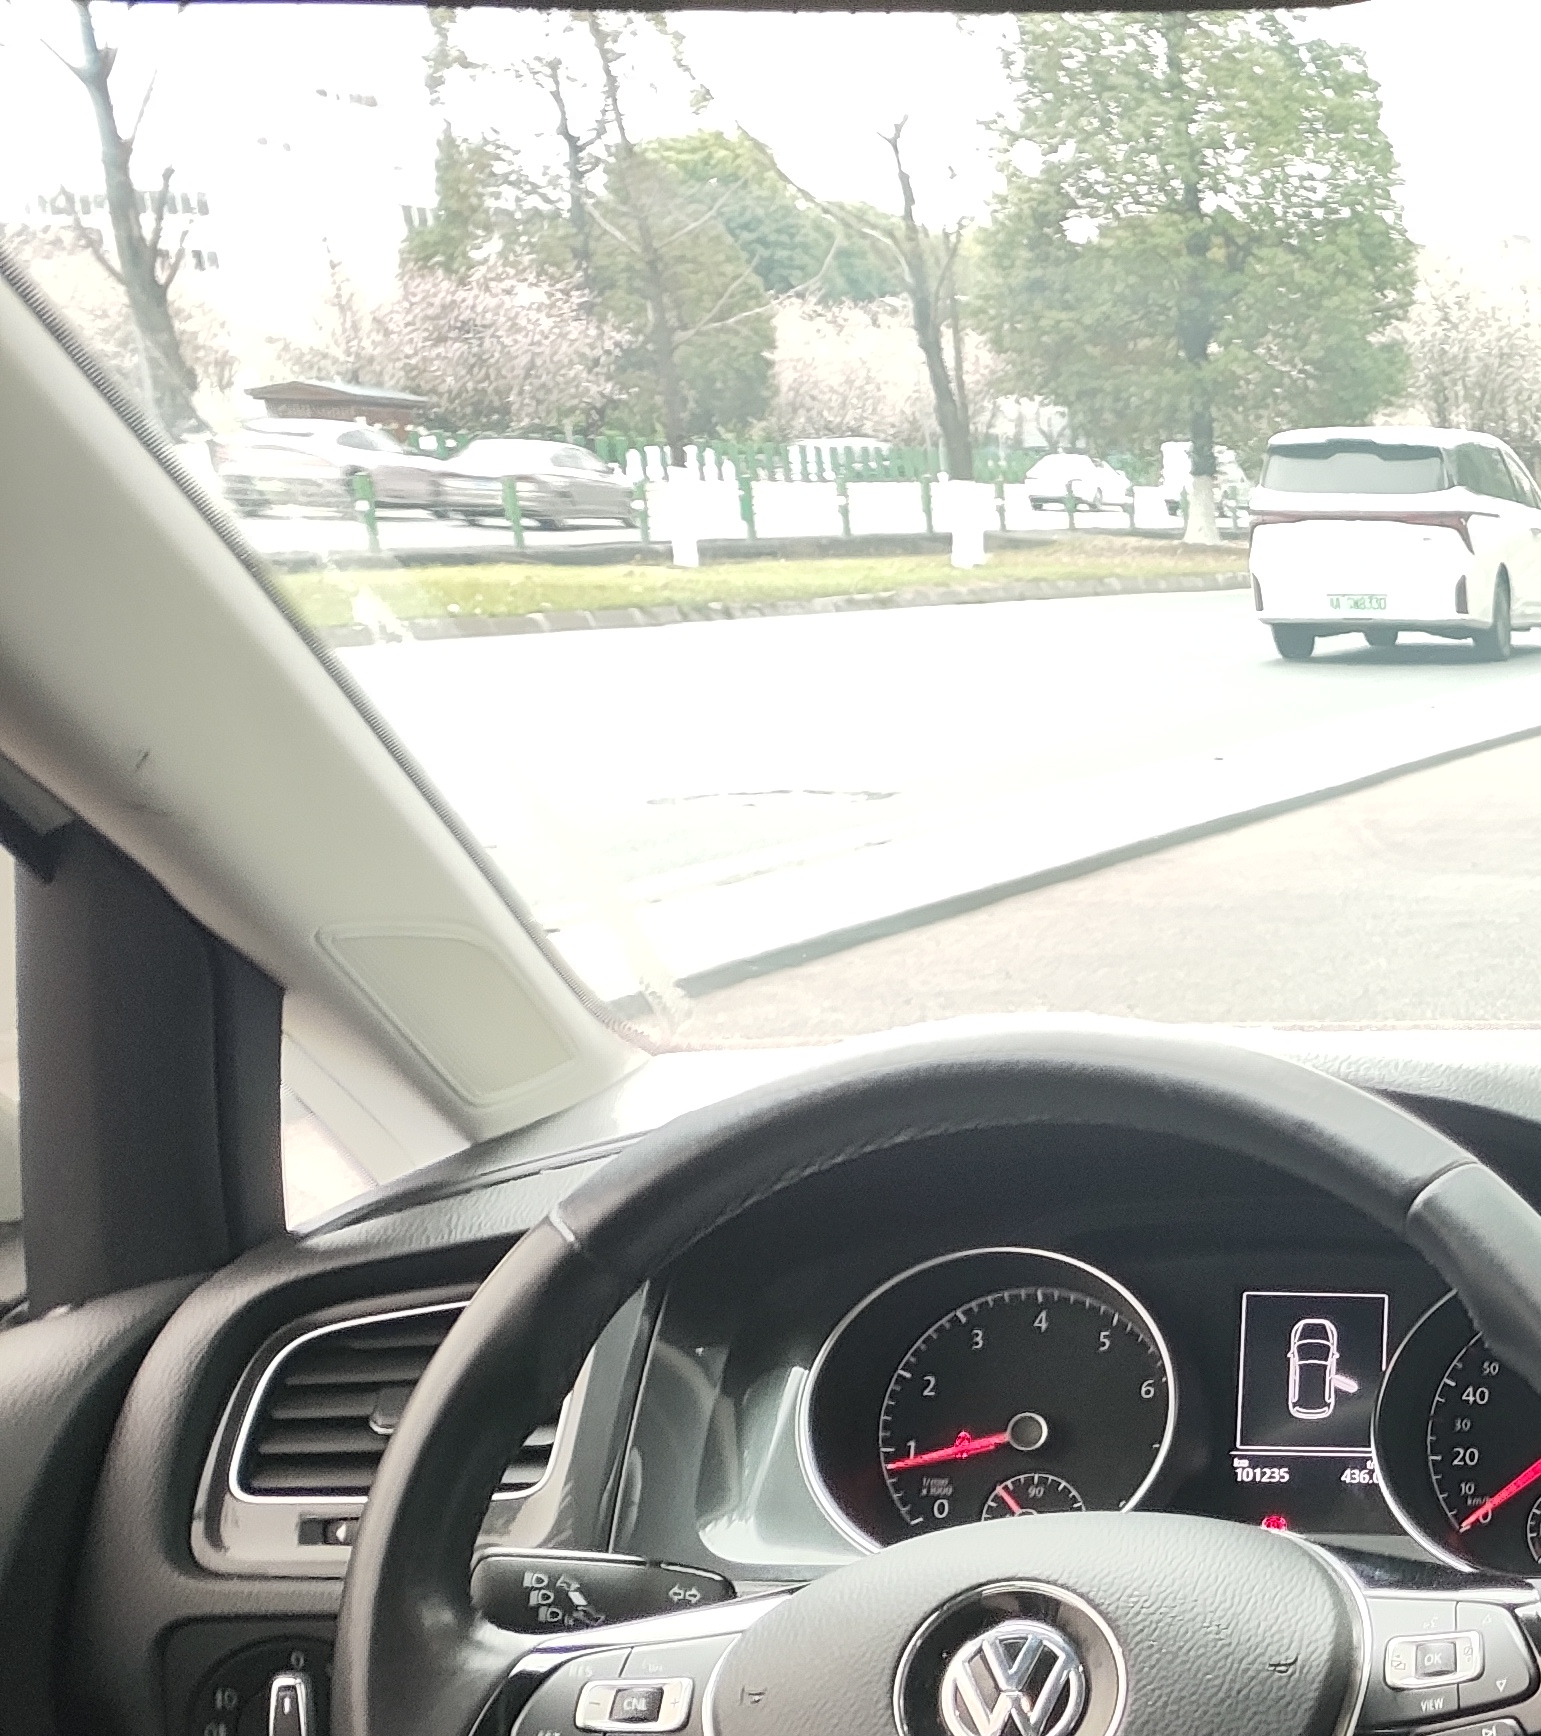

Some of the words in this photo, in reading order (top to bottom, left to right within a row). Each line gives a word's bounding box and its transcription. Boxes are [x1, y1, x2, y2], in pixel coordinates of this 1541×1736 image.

[1033, 1310, 1048, 1332] 4
[972, 1329, 984, 1350] 3
[1099, 1331, 1111, 1351] 5
[1482, 1361, 1499, 1376] 50
[922, 1375, 936, 1396] 2
[1140, 1379, 1155, 1398] 6
[1461, 1386, 1489, 1405] 40
[1454, 1418, 1471, 1432] 30
[1452, 1448, 1479, 1466] 20
[1235, 1467, 1290, 1483] 101235
[1027, 1486, 1044, 1498] 90
[1459, 1481, 1475, 1495] 10
[933, 1499, 949, 1519] 0
[1424, 1653, 1442, 1666] OK
[1421, 1697, 1444, 1713] VIEW
